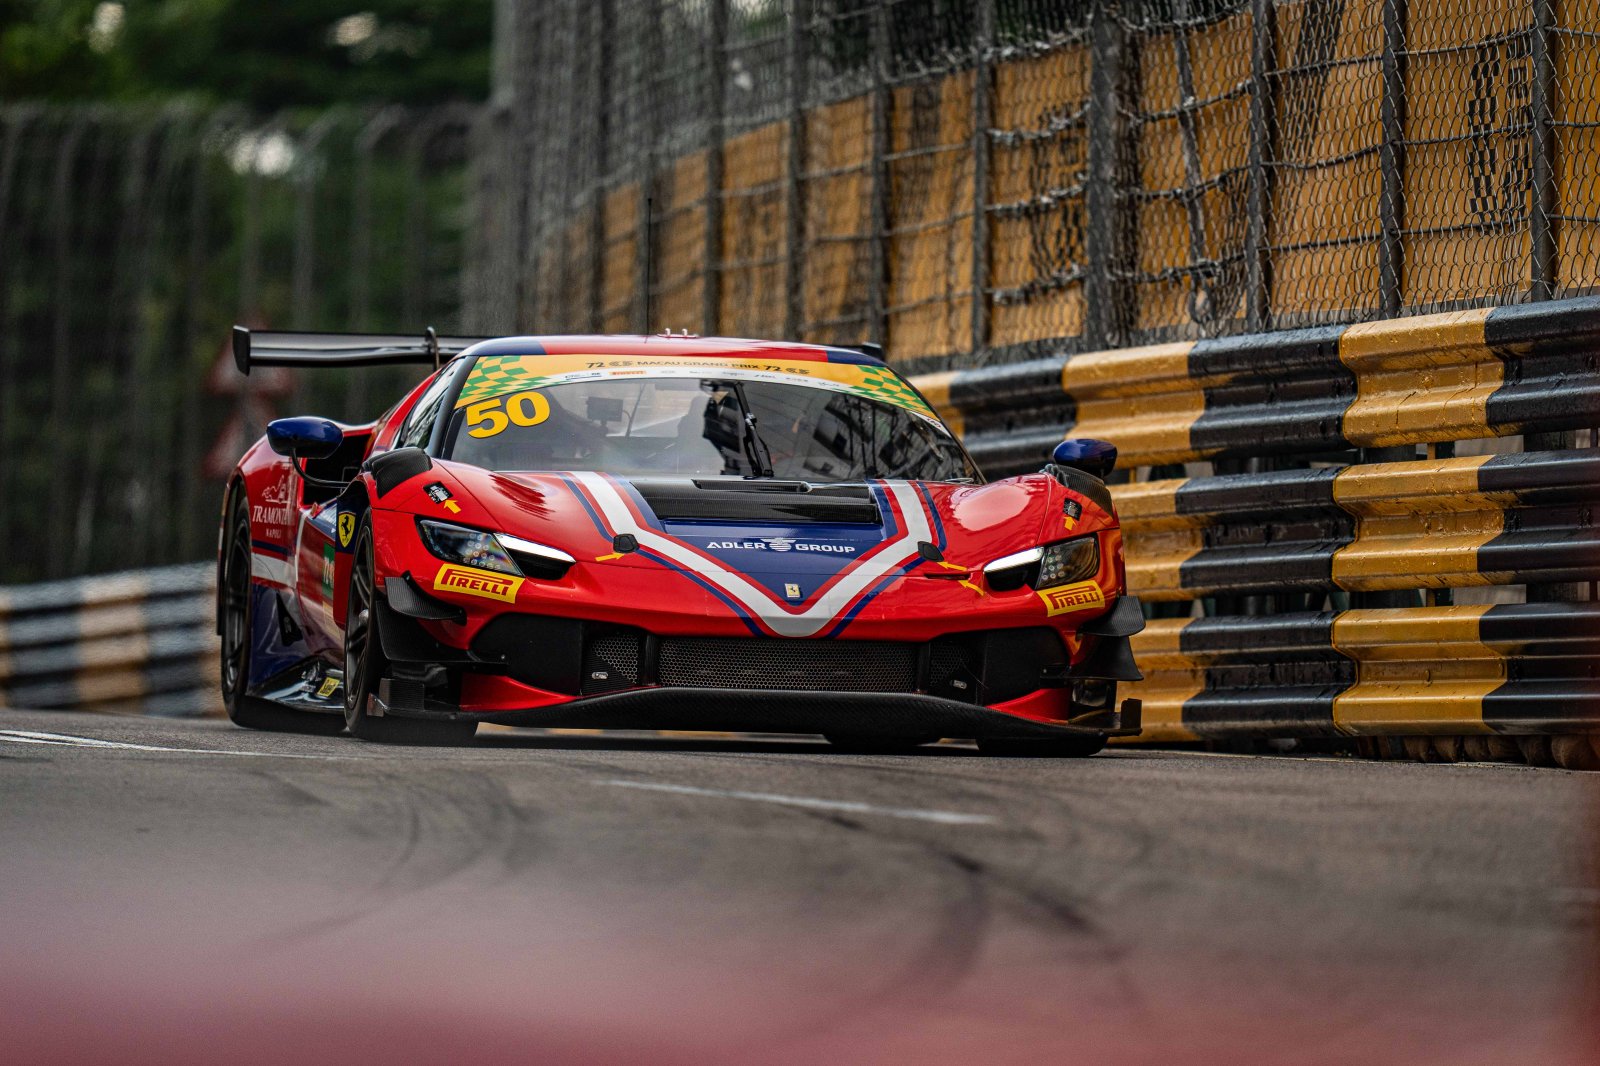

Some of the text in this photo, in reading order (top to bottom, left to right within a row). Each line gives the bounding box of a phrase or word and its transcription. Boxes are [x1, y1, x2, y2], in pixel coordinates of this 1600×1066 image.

[586, 361, 606, 369] 72
[465, 391, 551, 439] 50
[706, 541, 856, 553] ADLER GROUP
[441, 568, 514, 597] PIRELLI
[1046, 585, 1101, 611] PIRELLI
